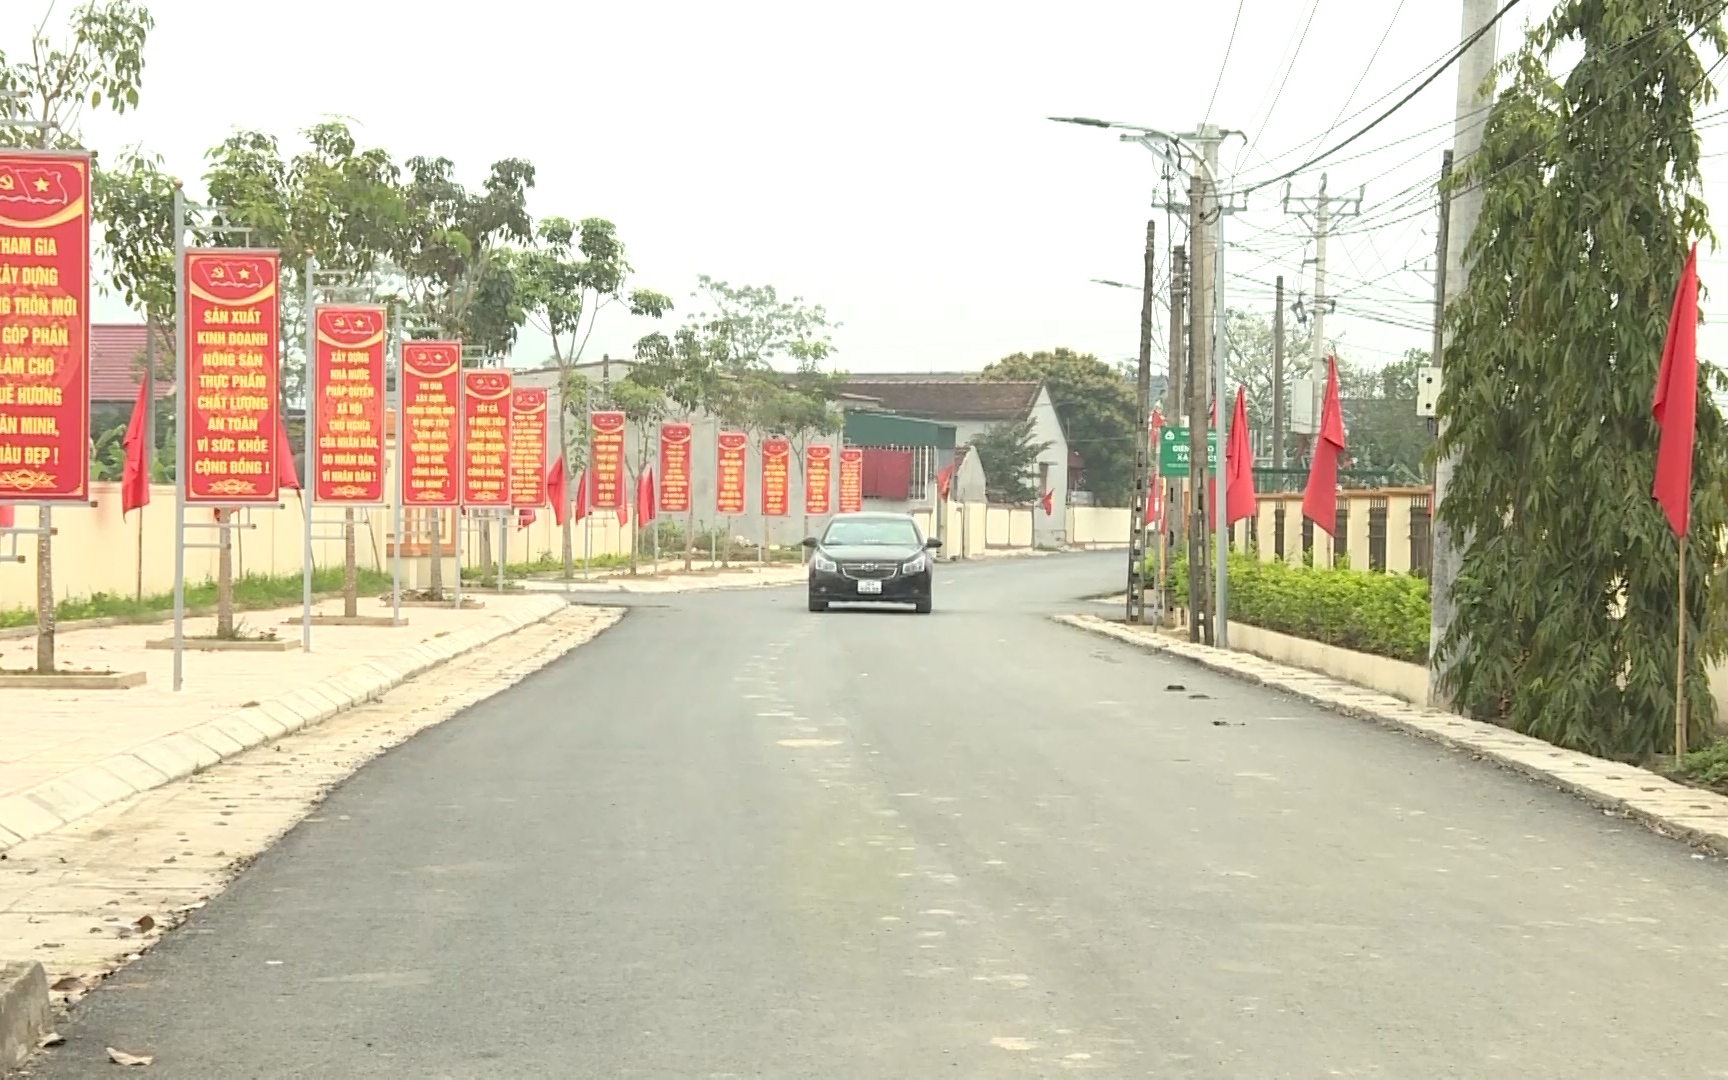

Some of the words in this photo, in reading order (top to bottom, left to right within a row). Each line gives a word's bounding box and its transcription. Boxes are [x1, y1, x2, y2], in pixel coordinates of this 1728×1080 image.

[34, 237, 58, 256] GIA
[22, 266, 58, 290] DỰNG
[14, 292, 48, 316] THÔN
[51, 294, 78, 316] MỚI
[204, 306, 229, 324] SẢN
[231, 306, 262, 324] XUẤT
[2, 323, 29, 345] GÓP
[32, 321, 69, 346] PHẦN
[197, 331, 226, 346] KINH
[228, 331, 268, 346] DOANH
[28, 357, 54, 376] CHO
[202, 350, 236, 368] NÔNG
[238, 349, 263, 368] SẢN
[200, 374, 229, 392] THỰC
[232, 369, 266, 389] PHẨM
[18, 386, 62, 407] HƯƠNG
[197, 393, 228, 410] CHẤT
[230, 395, 268, 412] LƯỢNG
[21, 416, 60, 438] MINH,
[208, 416, 225, 430] AN
[228, 415, 258, 432] TOÀN
[197, 435, 209, 452] VÌ
[211, 435, 236, 453] SỨC
[238, 434, 269, 454] KHỎE
[25, 446, 50, 468] ĐẸP
[54, 447, 59, 466] !
[195, 457, 228, 476] CỘNG
[230, 456, 263, 476] ĐỒNG
